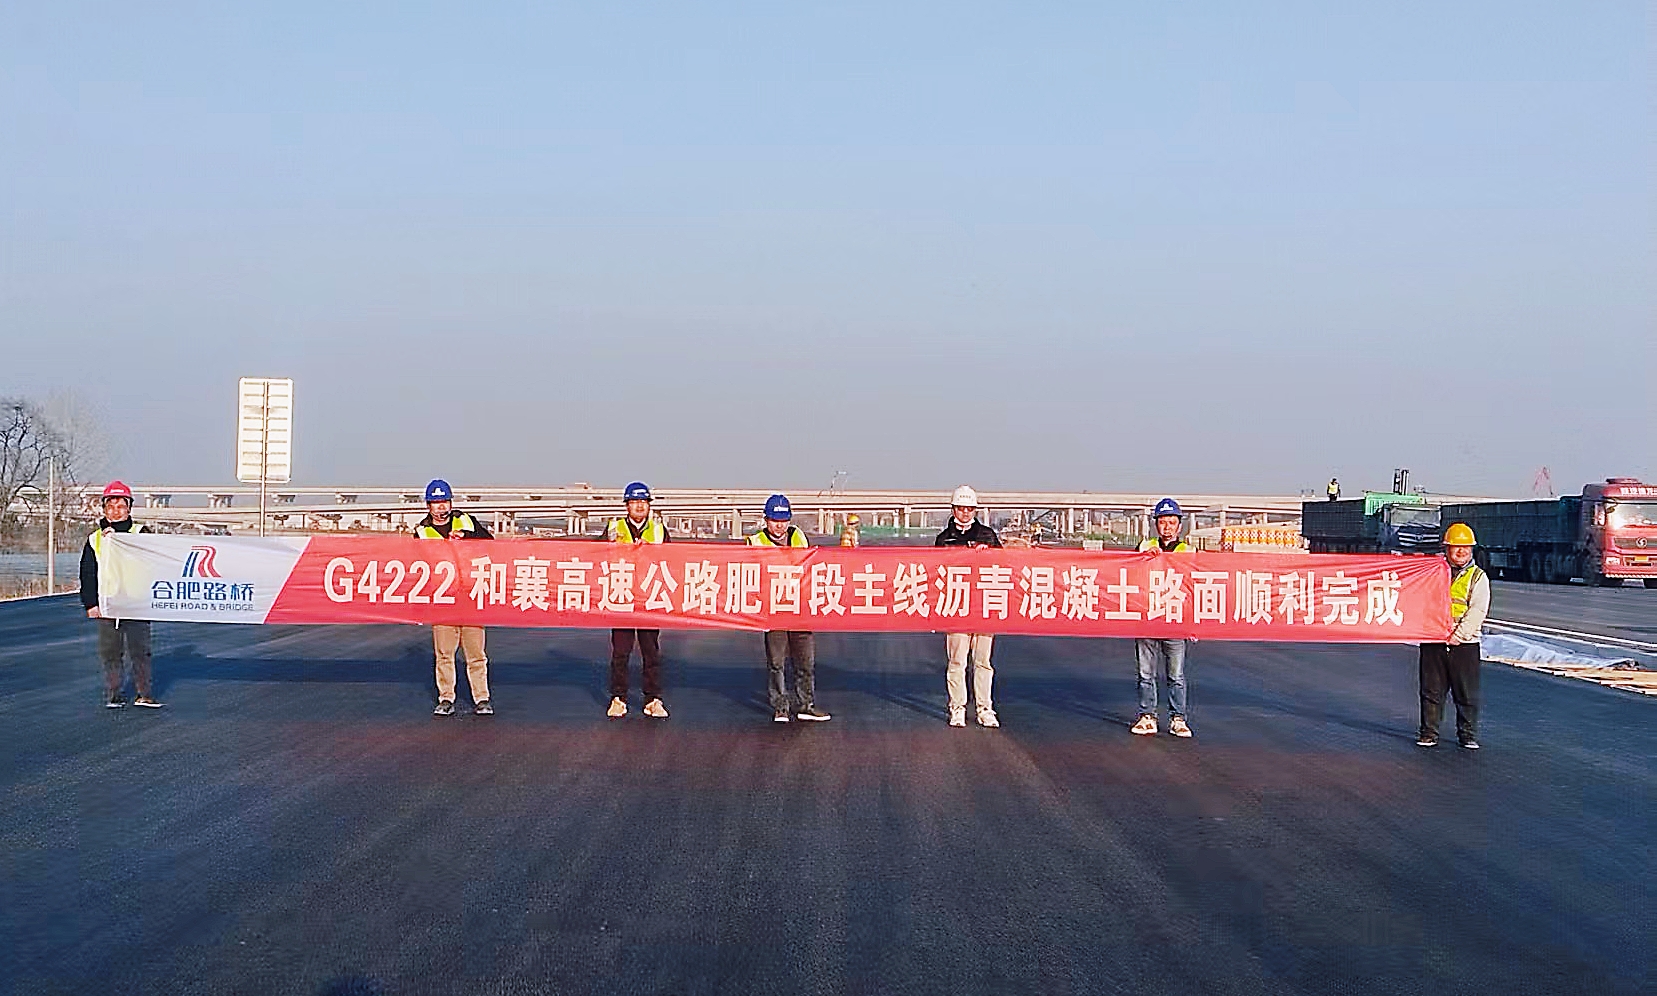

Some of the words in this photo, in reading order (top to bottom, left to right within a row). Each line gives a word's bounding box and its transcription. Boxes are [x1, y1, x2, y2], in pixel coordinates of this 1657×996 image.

[151, 580, 255, 601] 合肥路桥
[324, 557, 456, 604] G4222
[469, 555, 1404, 627] 和襄高速公路肥西段主线沥青混凝土路面顺利完成
[151, 601, 178, 609] HEFEI
[180, 602, 208, 610] ROAD
[210, 603, 217, 611] &
[218, 603, 254, 612] BRIDGE
